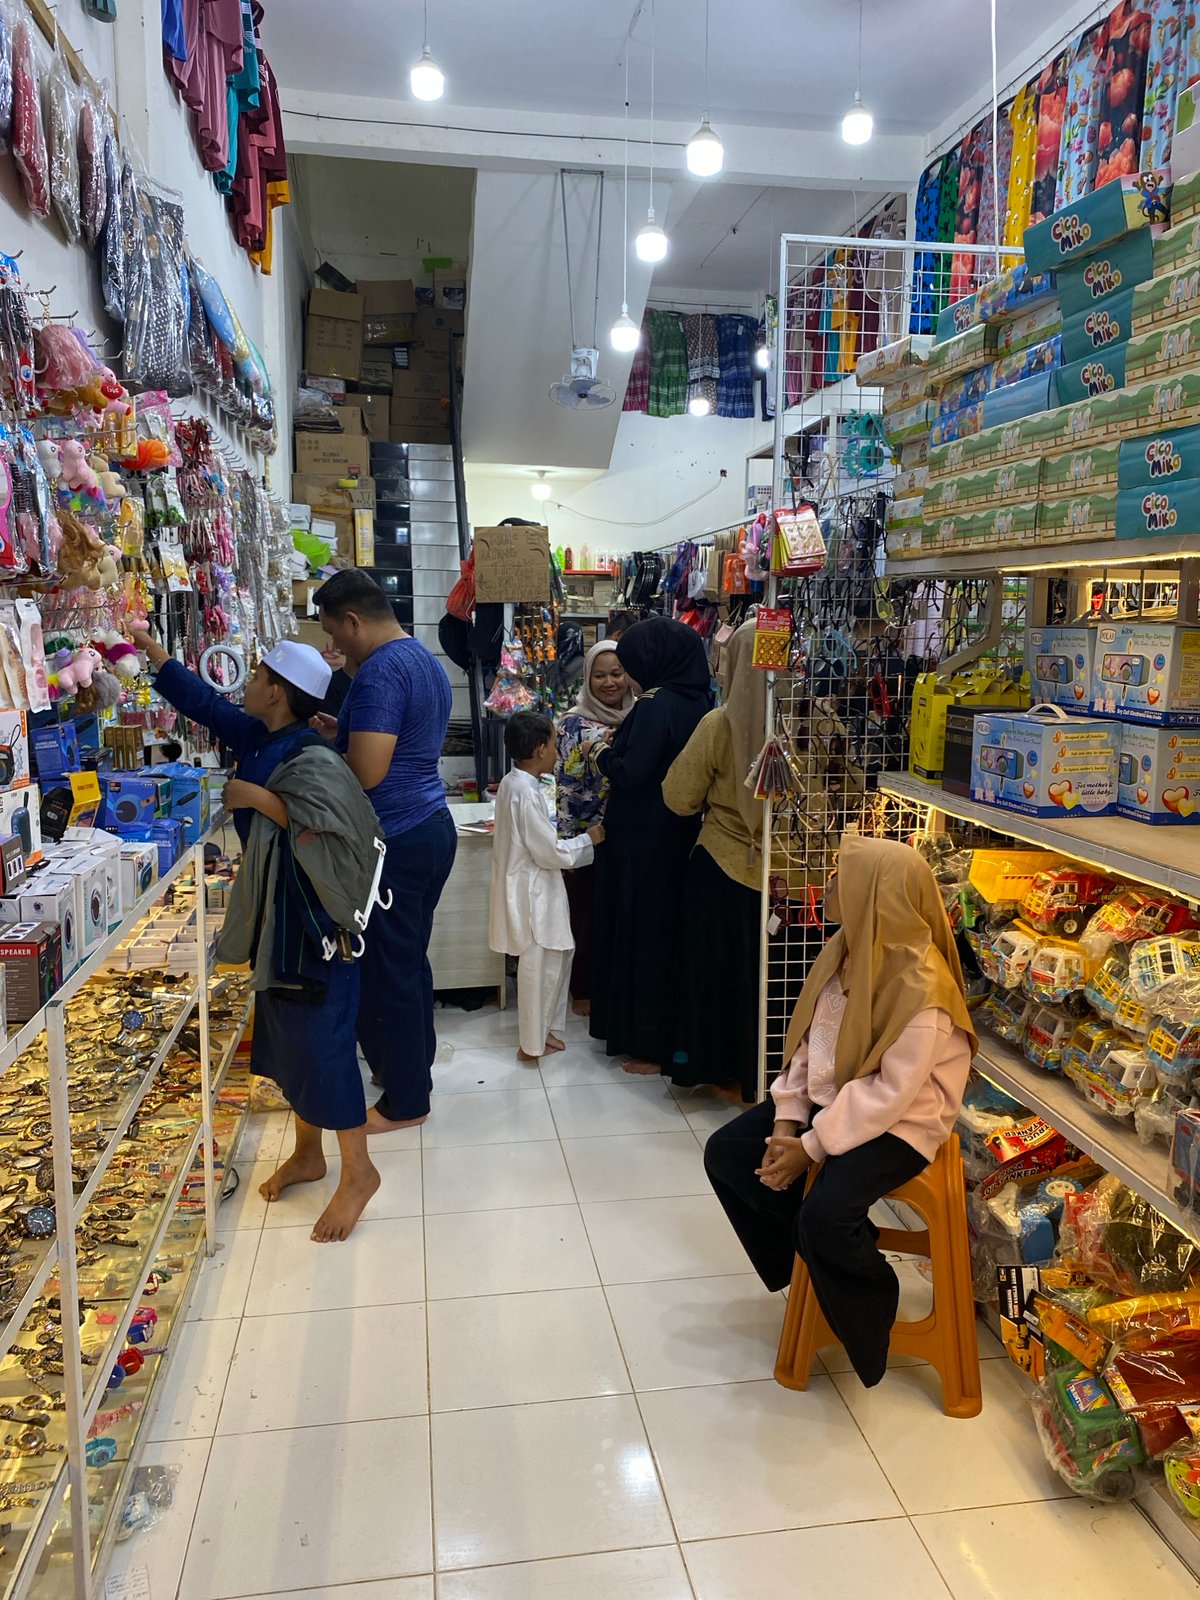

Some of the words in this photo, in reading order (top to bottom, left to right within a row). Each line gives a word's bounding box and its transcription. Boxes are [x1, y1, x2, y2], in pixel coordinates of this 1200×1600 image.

[759, 611, 768, 620] 72
[0, 948, 32, 956] SPEAKER
[1003, 1122, 1039, 1137] TANKER
[1022, 1123, 1051, 1143] TRUCK
